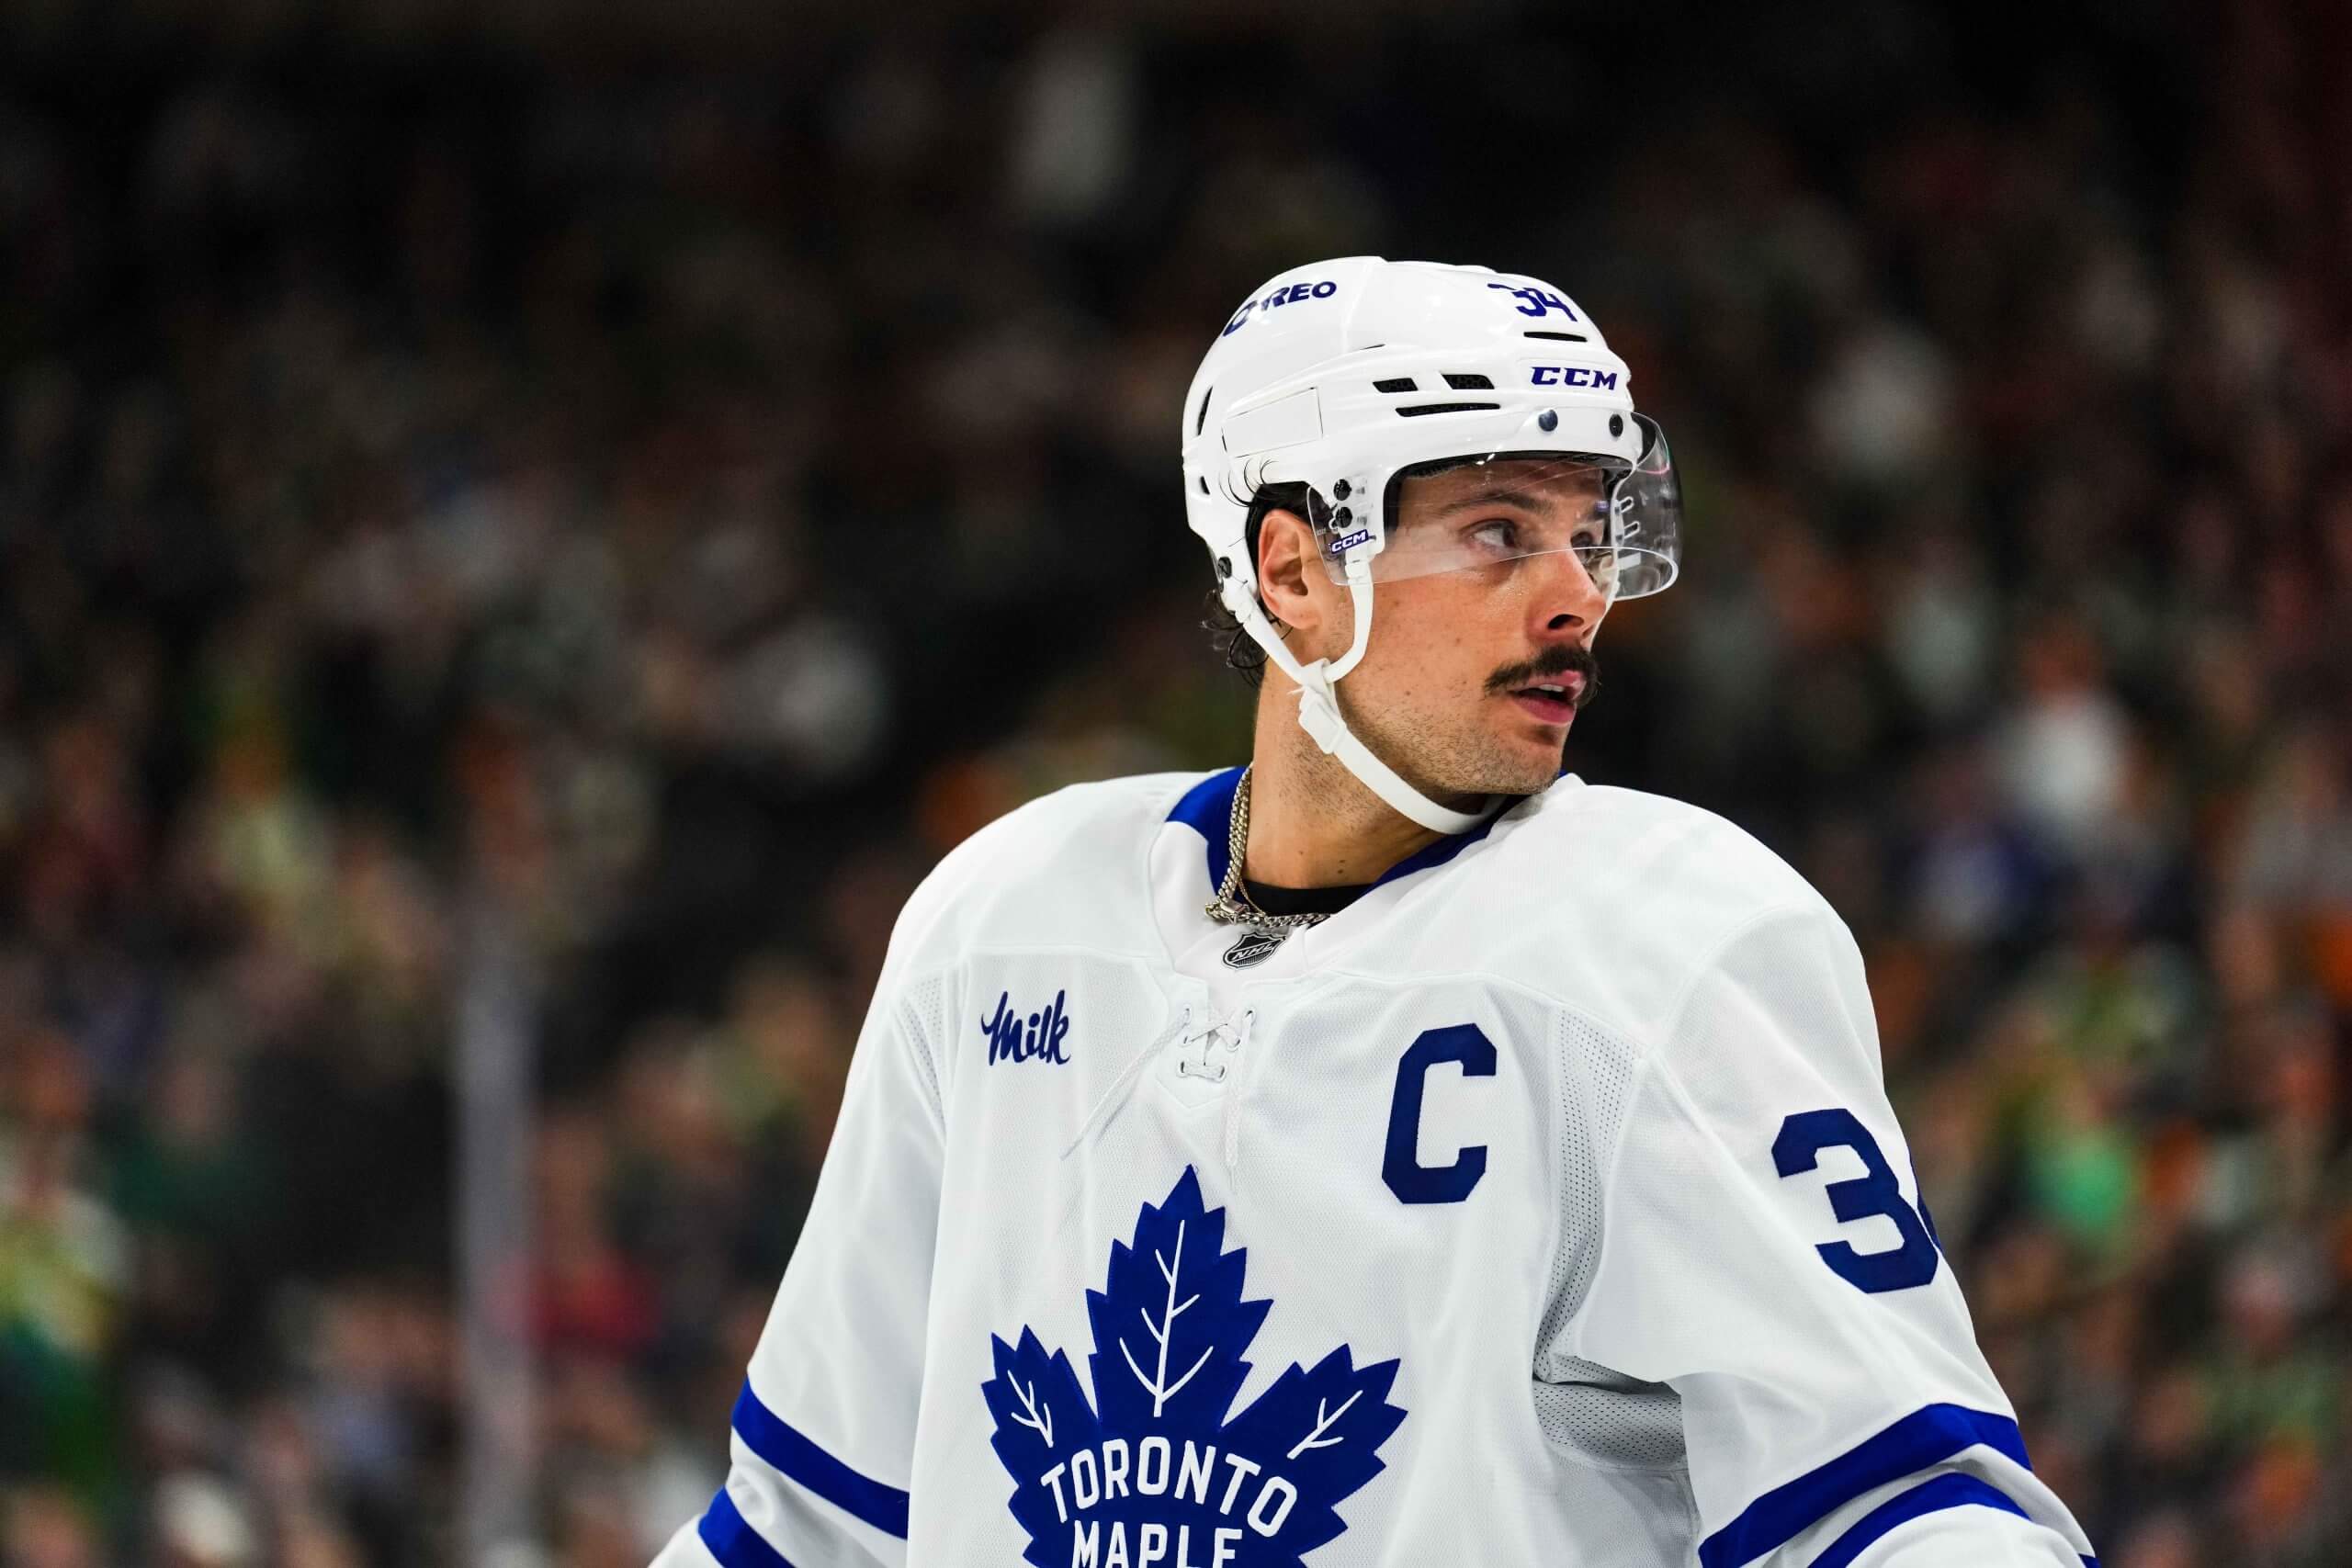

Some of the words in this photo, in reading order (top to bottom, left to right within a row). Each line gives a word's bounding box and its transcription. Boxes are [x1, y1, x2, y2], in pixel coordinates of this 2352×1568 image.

[1531, 367, 1618, 390] CCM
[1331, 530, 1367, 554] CCM
[1231, 942, 1275, 961] NHL
[980, 988, 1071, 1066] Milk
[1382, 1022, 1497, 1205] C
[1040, 1436, 1297, 1538] TORONTO
[1071, 1519, 1242, 1568] MAPLE
